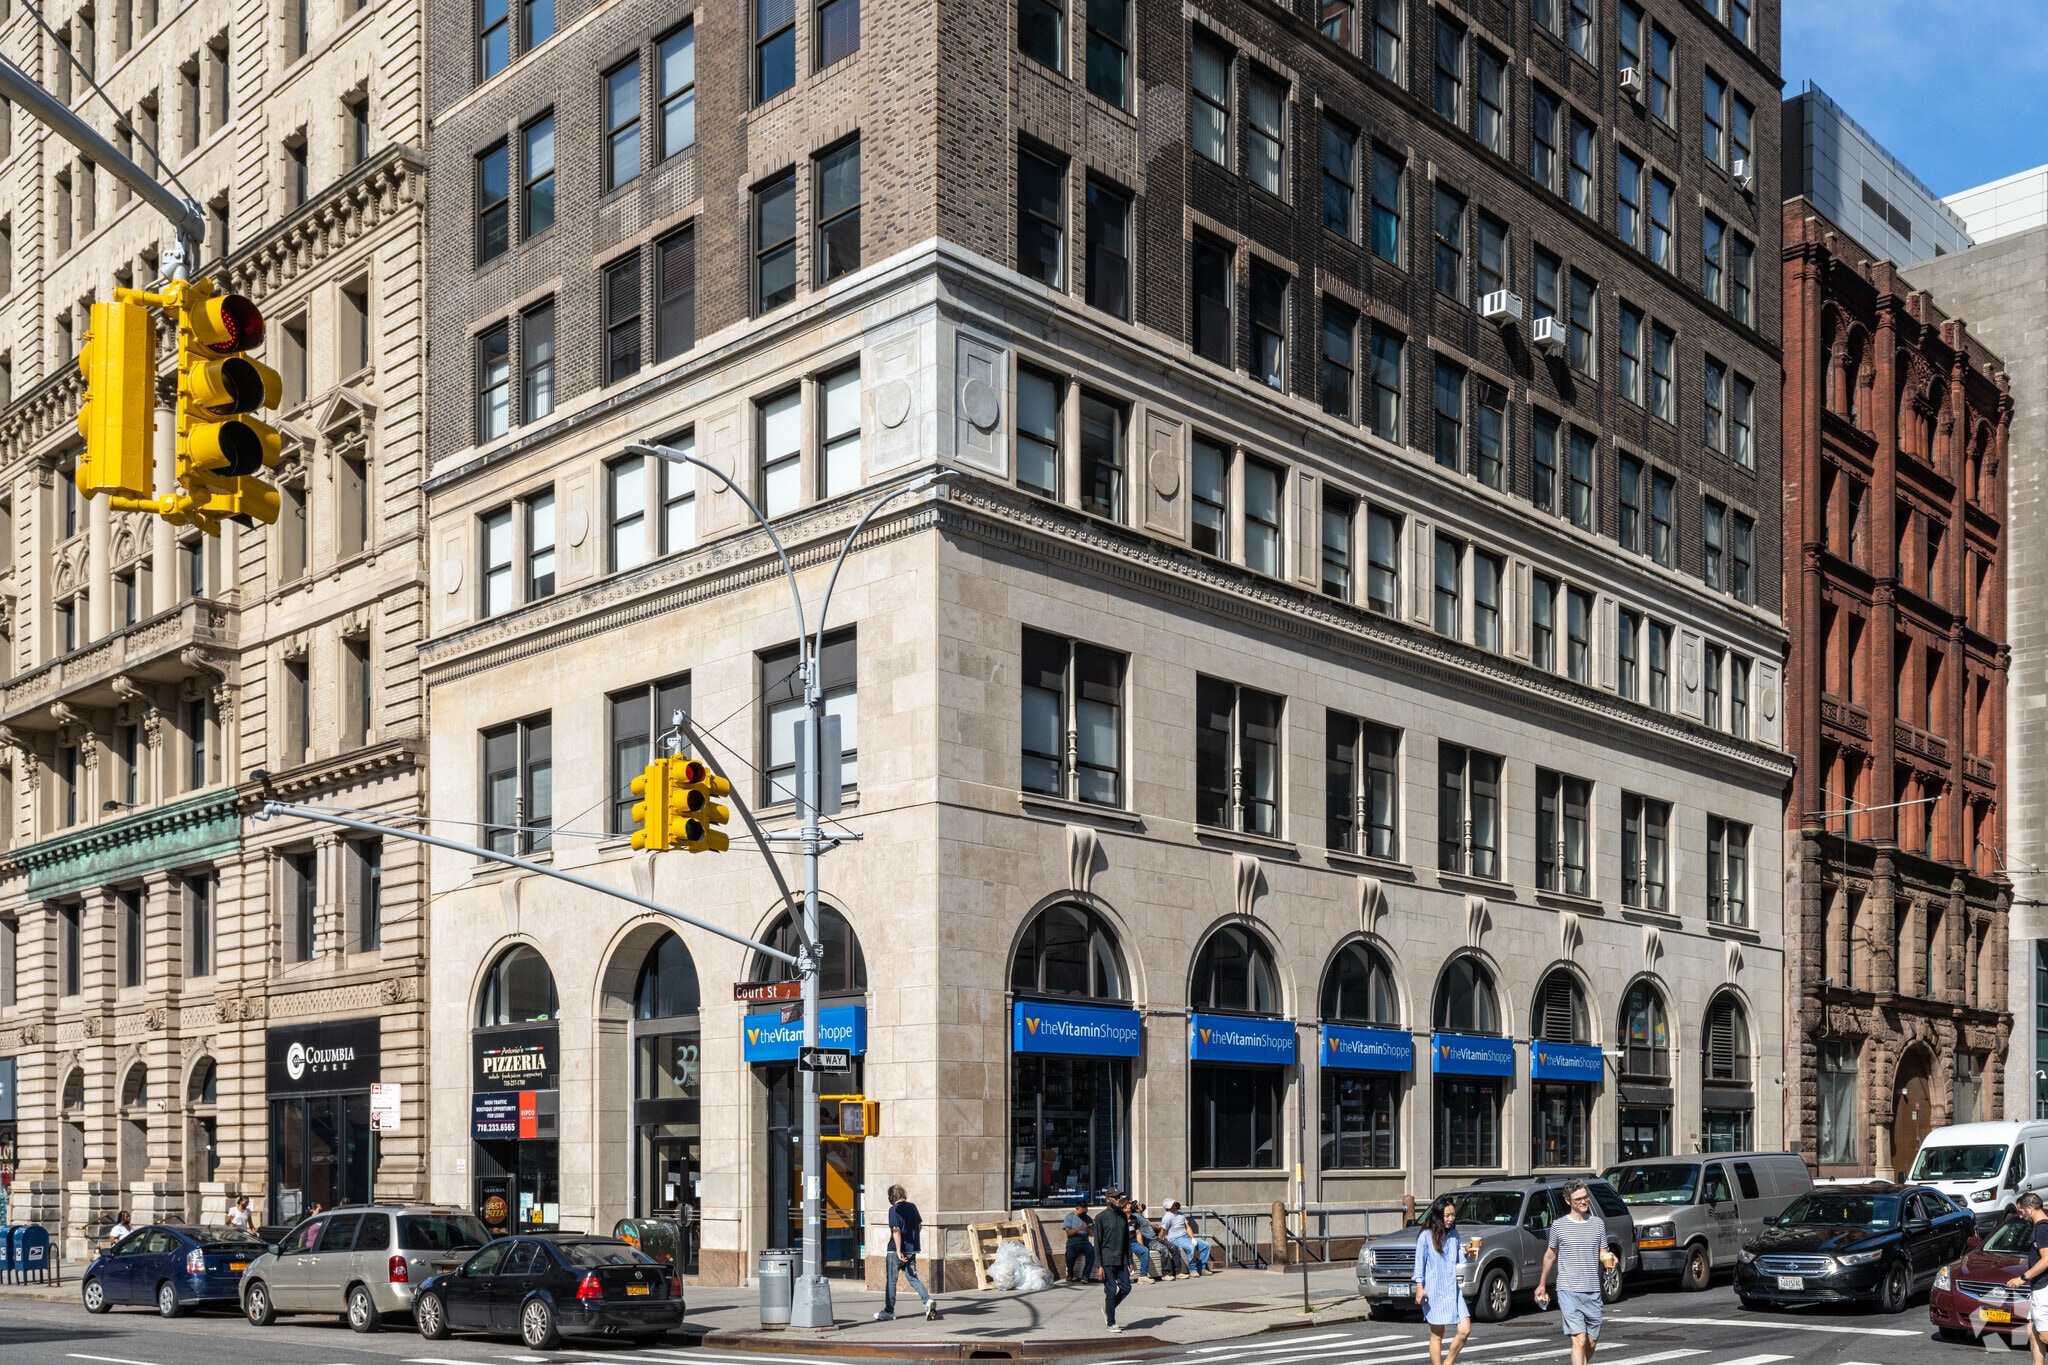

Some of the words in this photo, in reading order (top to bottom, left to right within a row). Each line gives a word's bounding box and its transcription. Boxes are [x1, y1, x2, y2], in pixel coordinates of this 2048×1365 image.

[736, 987, 763, 999] Court
[767, 986, 777, 998] St
[1041, 1020, 1138, 1043] theVitaminShoppe
[1212, 1030, 1293, 1051] theVitaminShoppe
[501, 1045, 525, 1055] Antonio's
[1340, 1040, 1410, 1059] theVitaminShoppe
[1450, 1047, 1511, 1065] theVitaminShoppe
[312, 1062, 348, 1072] CARE
[482, 1053, 547, 1073] PIZZERIA
[673, 1045, 698, 1086] 32
[826, 1056, 843, 1064] WAY
[1547, 1054, 1601, 1071] theVitaminShoppe
[477, 1123, 515, 1132] 718.233.6565
[485, 1209, 504, 1217] PIZZA
[486, 1201, 503, 1210] BEST
